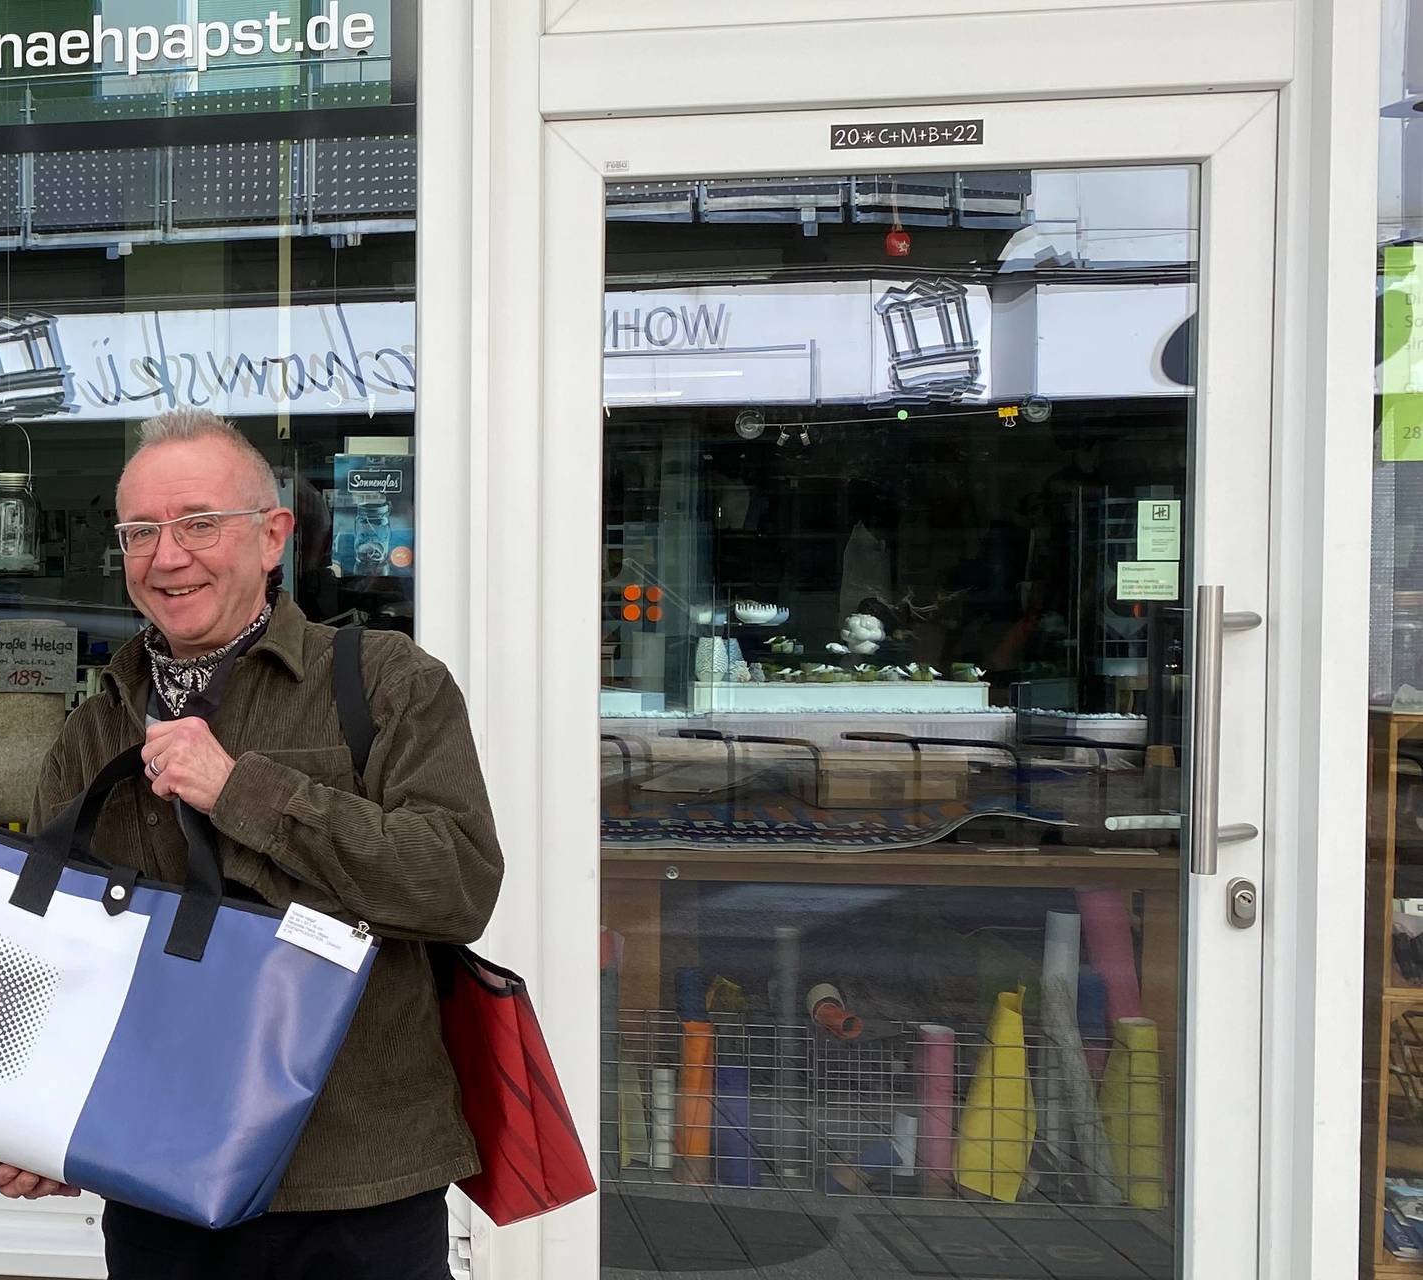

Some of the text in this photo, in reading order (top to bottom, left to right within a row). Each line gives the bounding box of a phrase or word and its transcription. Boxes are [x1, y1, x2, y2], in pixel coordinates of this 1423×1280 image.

[350, 474, 399, 493] Sonnenglas
[31, 637, 73, 655] Helga
[8, 670, 53, 686] 189.-
